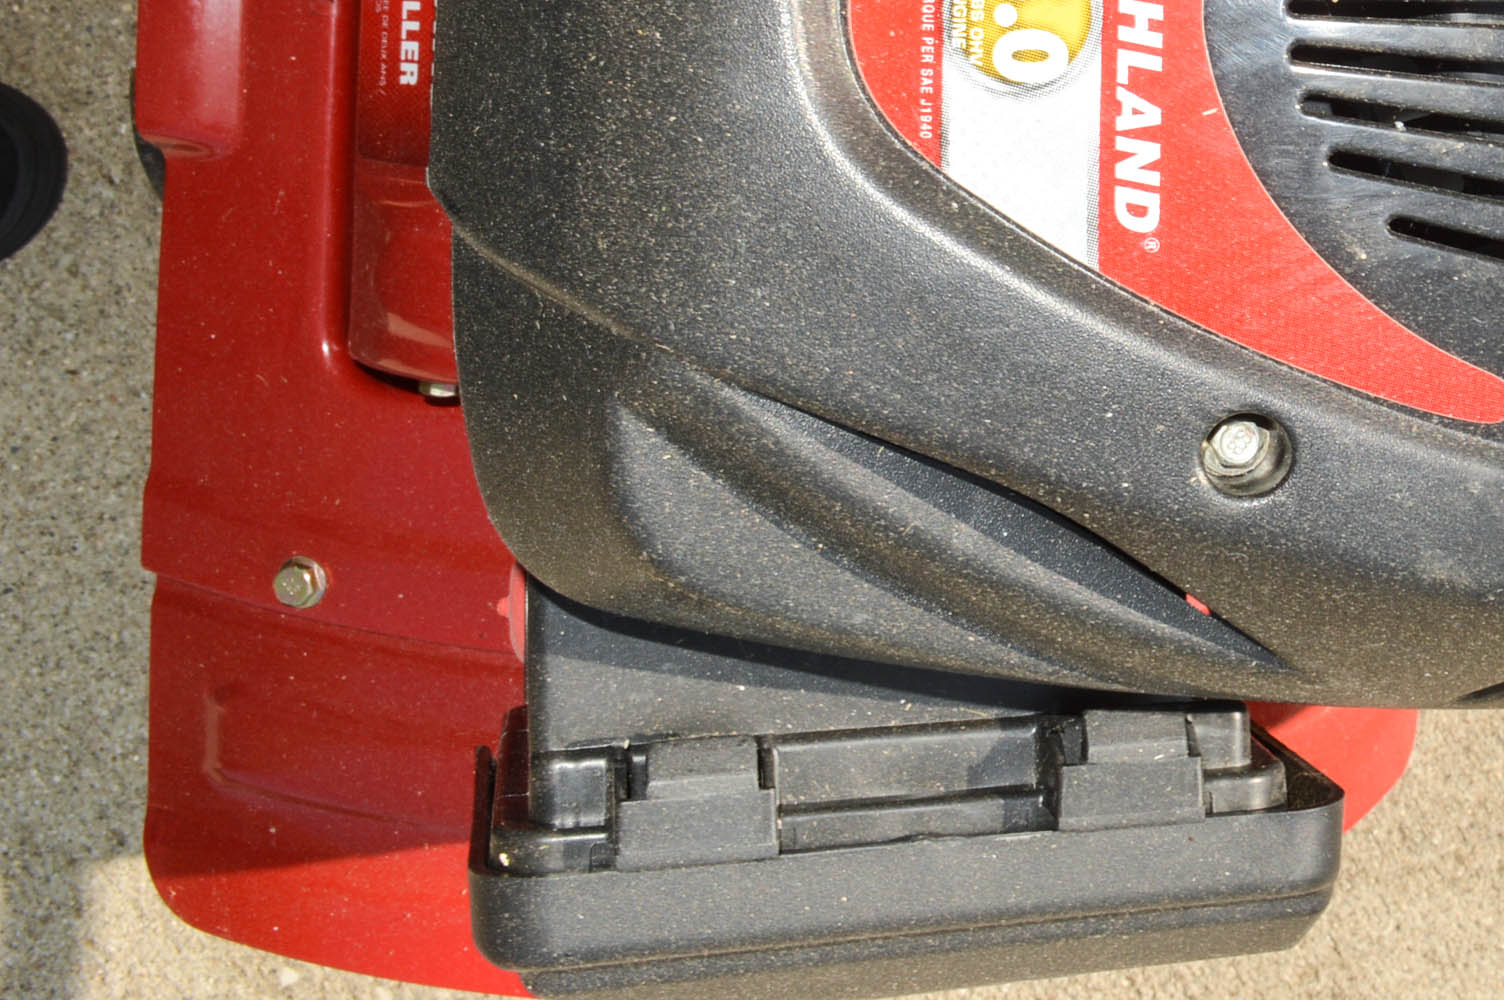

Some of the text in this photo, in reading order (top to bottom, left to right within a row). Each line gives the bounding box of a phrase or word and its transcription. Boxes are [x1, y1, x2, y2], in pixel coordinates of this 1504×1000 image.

[920, 36, 935, 63] PER
[968, 28, 985, 67] OHV
[919, 68, 934, 94] SAE
[919, 99, 932, 139] J1940
